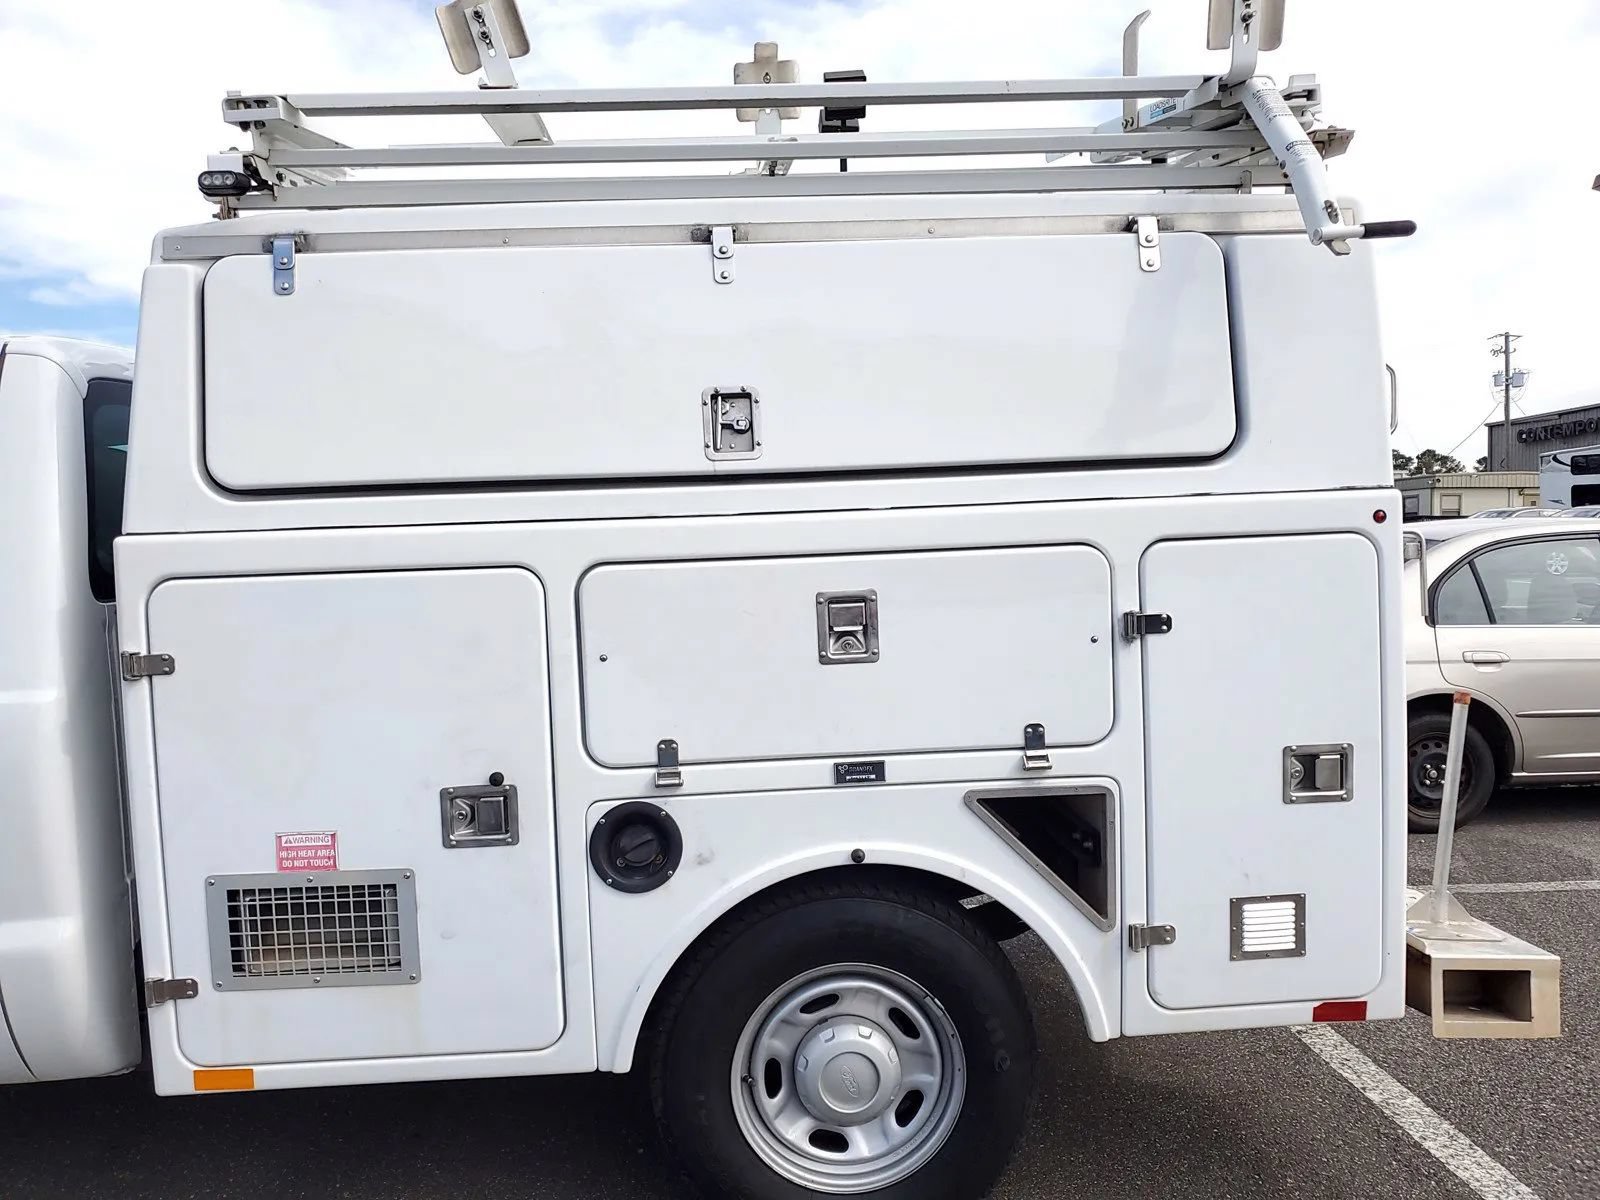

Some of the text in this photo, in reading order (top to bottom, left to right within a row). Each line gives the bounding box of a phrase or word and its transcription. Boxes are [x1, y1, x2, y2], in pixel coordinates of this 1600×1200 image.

[1517, 416, 1600, 443] CONTEMPO
[293, 835, 330, 844] WARNING
[279, 849, 336, 858] HIGH HEAT AREA
[282, 859, 334, 868] DO NOT TOUCH
